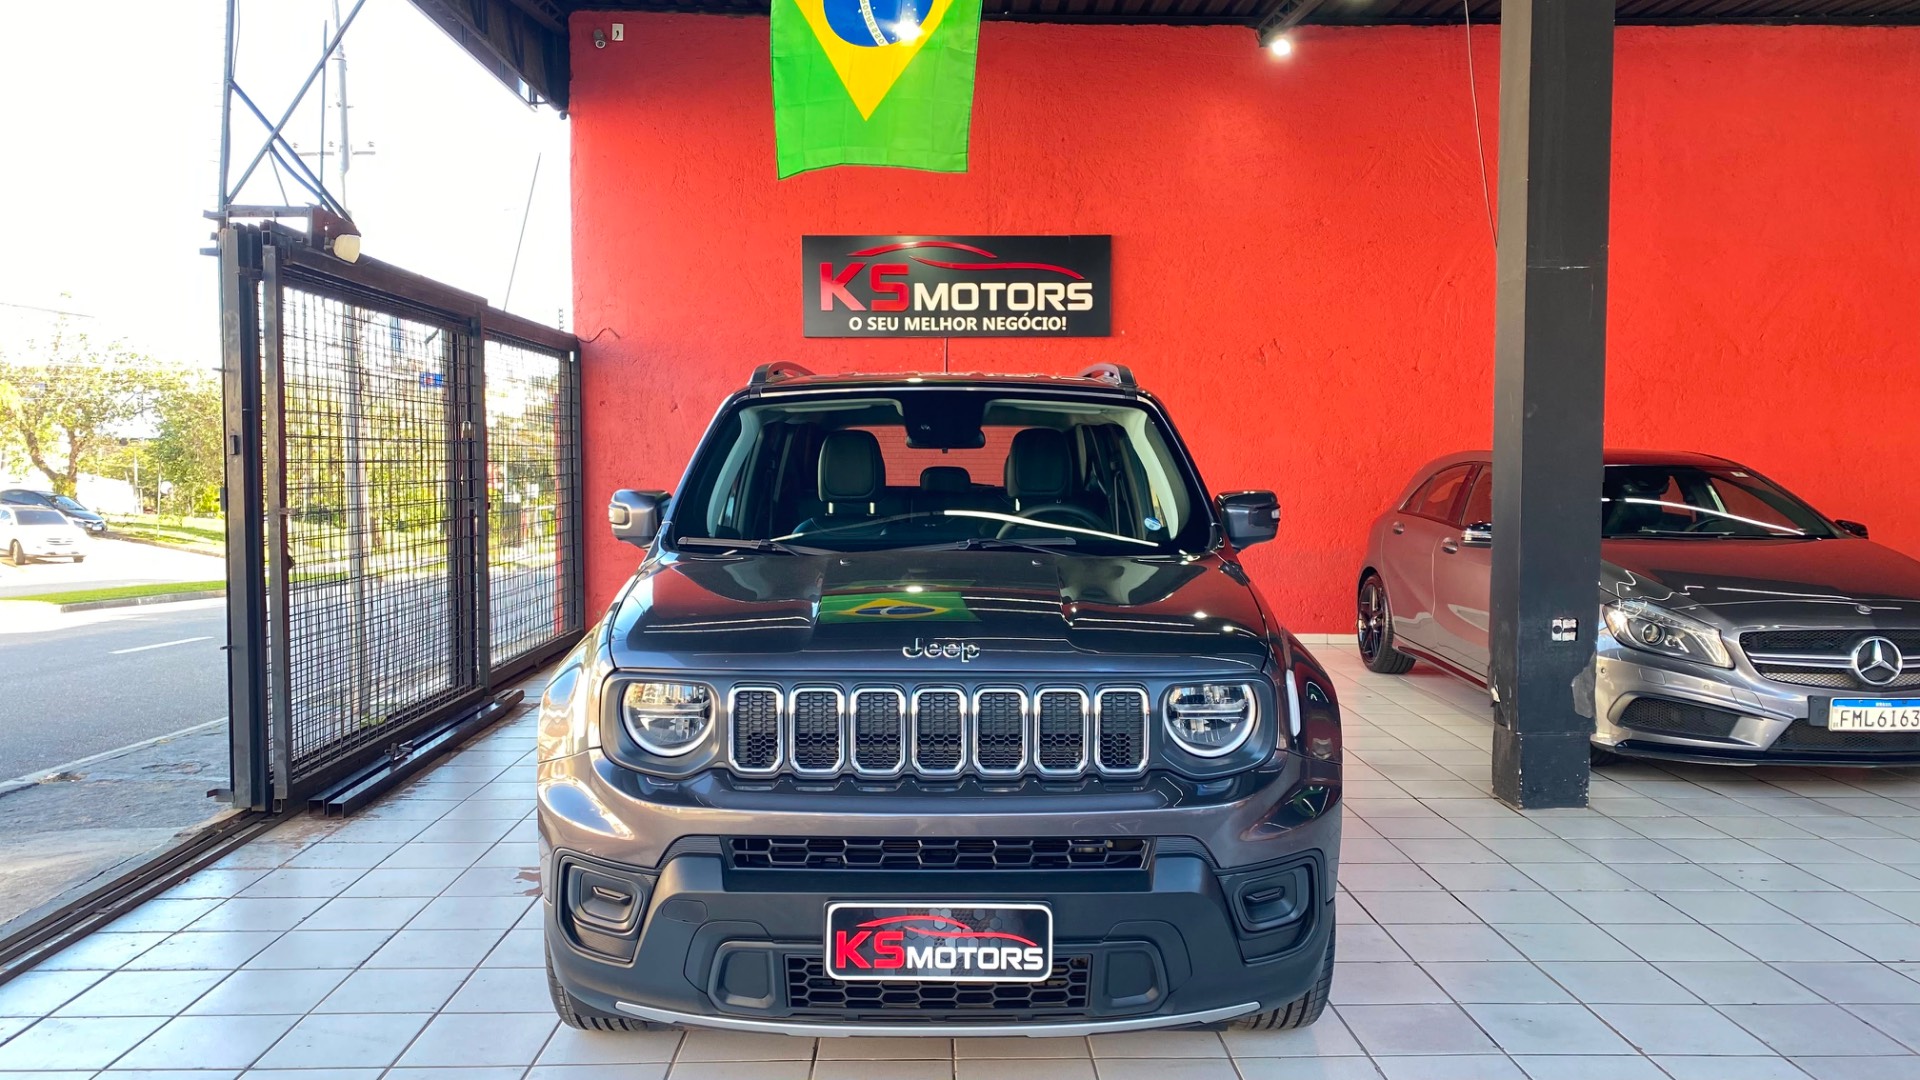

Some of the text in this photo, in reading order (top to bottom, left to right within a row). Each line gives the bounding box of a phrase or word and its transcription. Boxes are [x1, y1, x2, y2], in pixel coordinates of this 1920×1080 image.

[819, 262, 1094, 312] KS MOTORS
[848, 312, 1068, 331] O SEU MELHOR NEGÓCIO!
[902, 637, 981, 663] Jeep
[835, 930, 1044, 970] KS MOTORS
